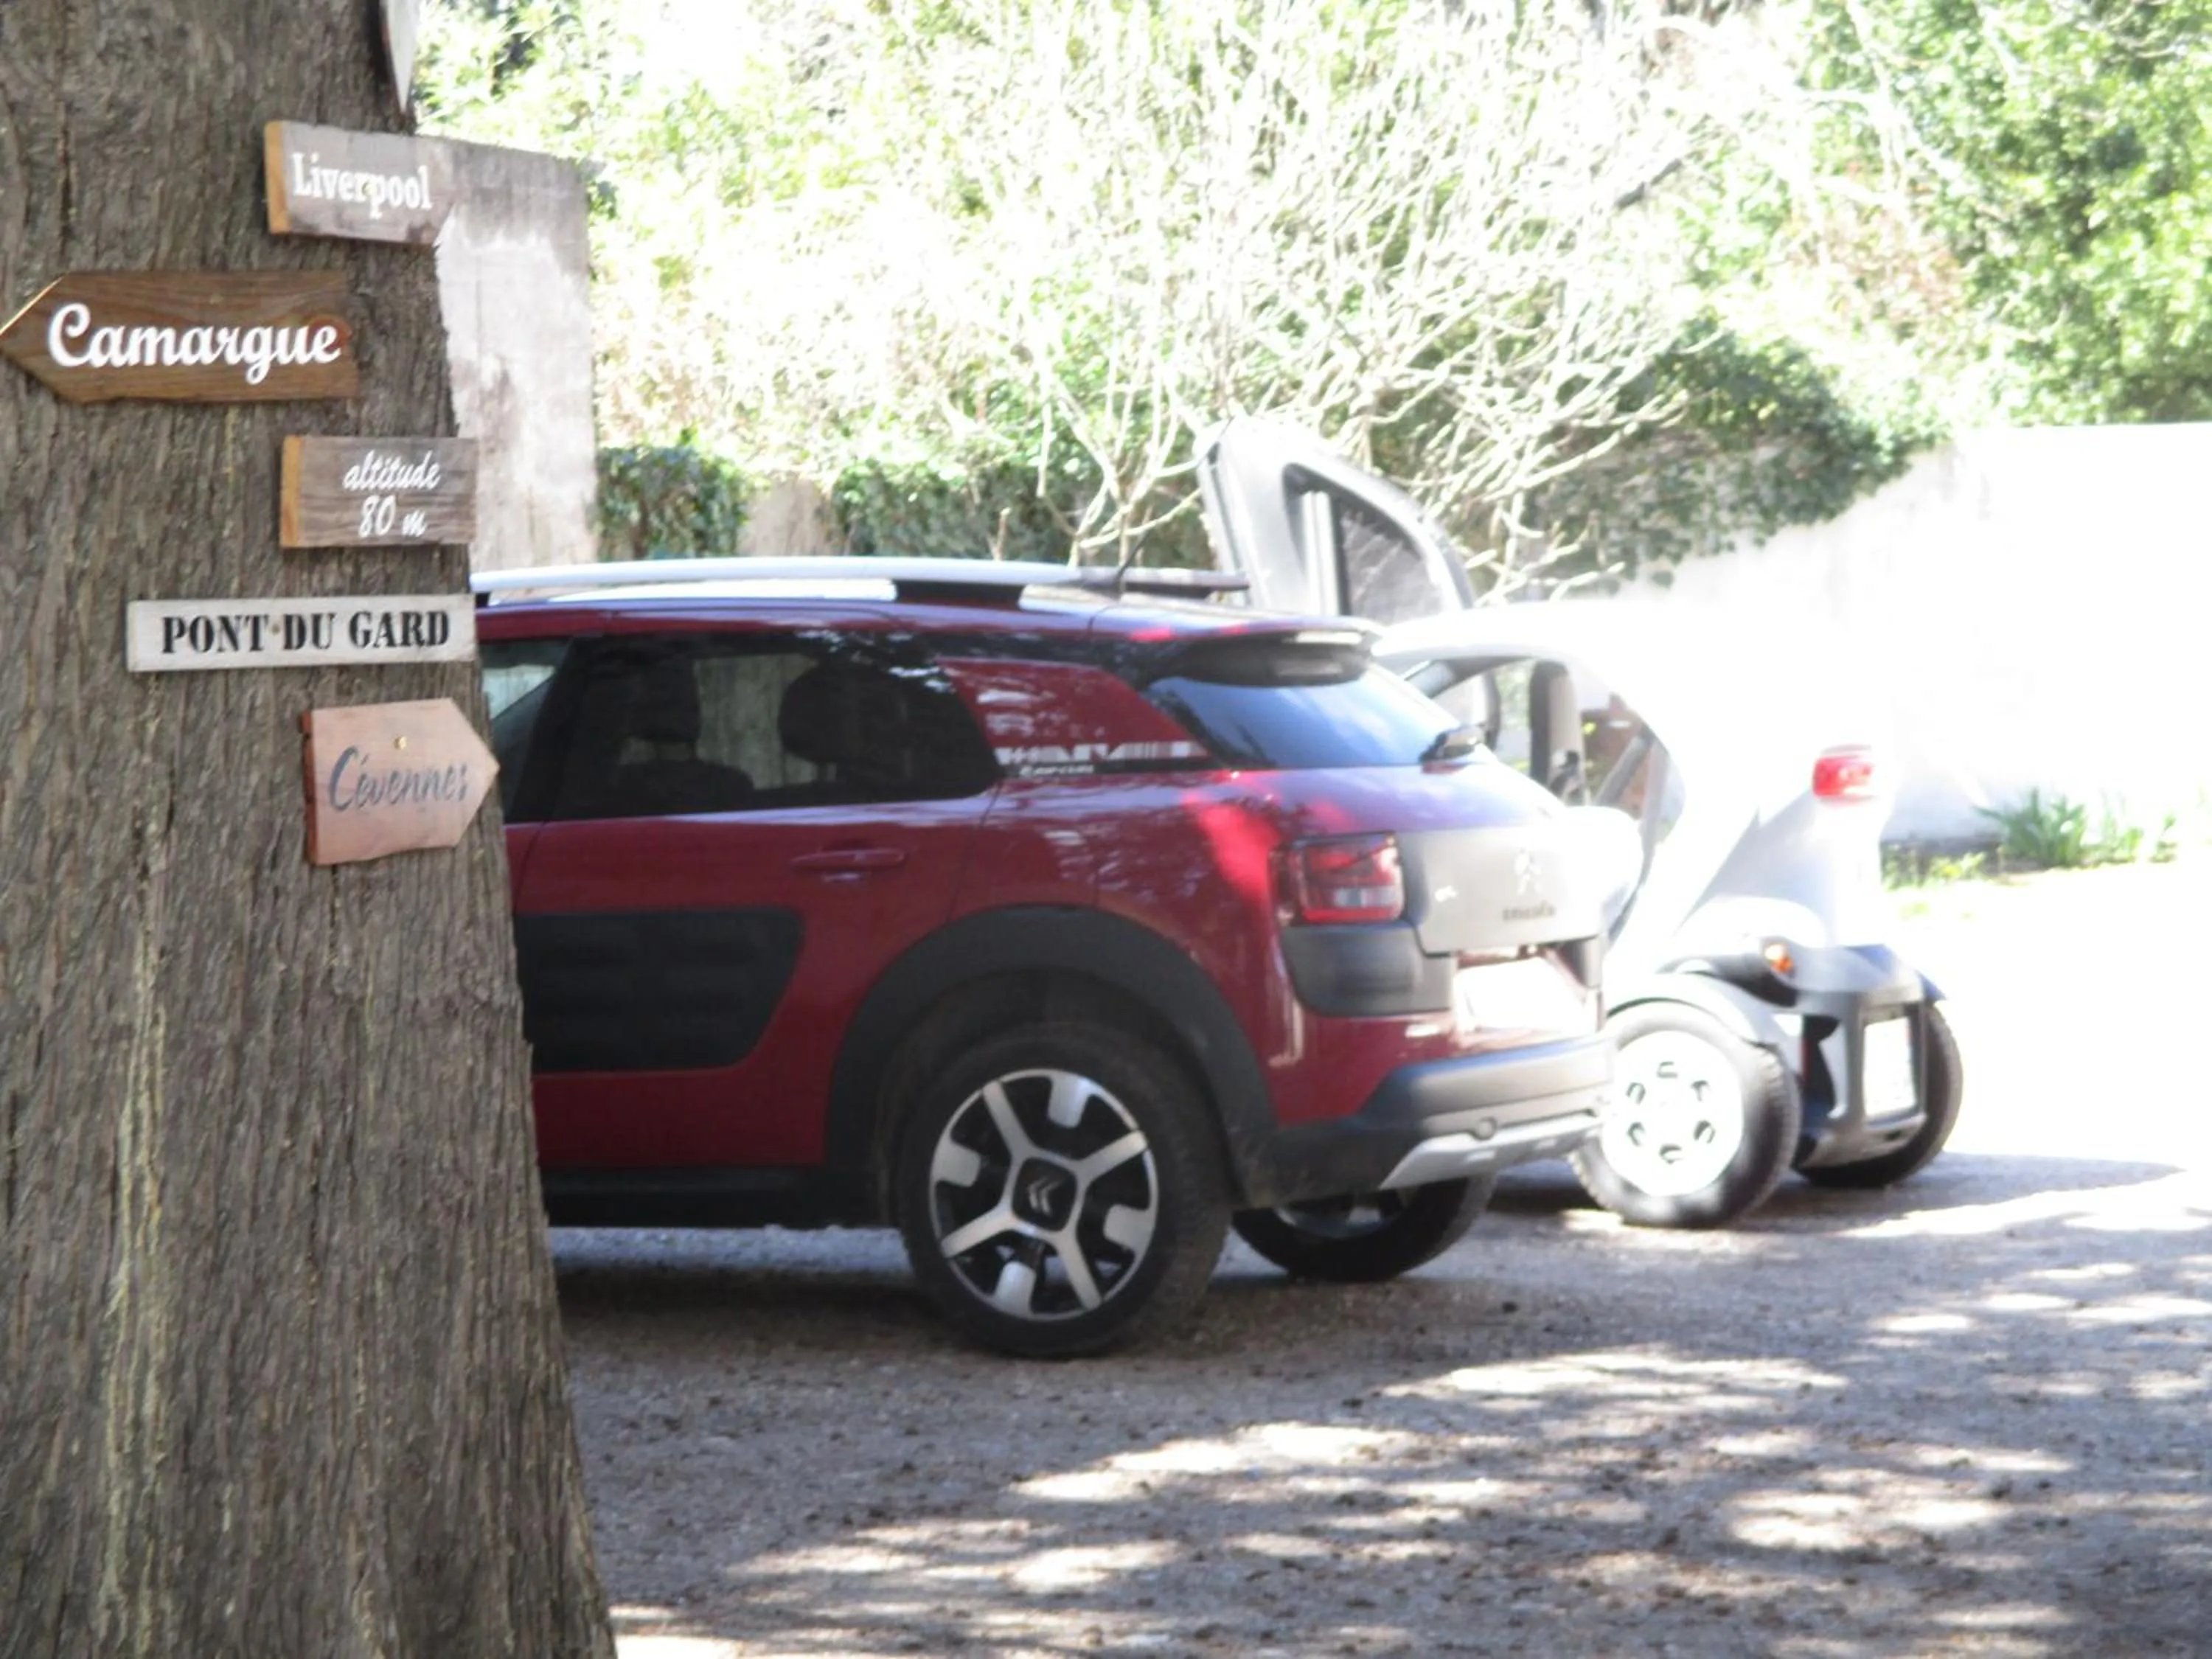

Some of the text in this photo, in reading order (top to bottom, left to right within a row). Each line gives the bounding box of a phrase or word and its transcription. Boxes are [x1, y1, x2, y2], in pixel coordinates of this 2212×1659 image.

[291, 152, 433, 218] Liverpool
[48, 304, 341, 384] Camargue
[343, 449, 441, 490] altitude
[358, 495, 428, 538] 80 m
[161, 610, 450, 654] PONT DU GARD
